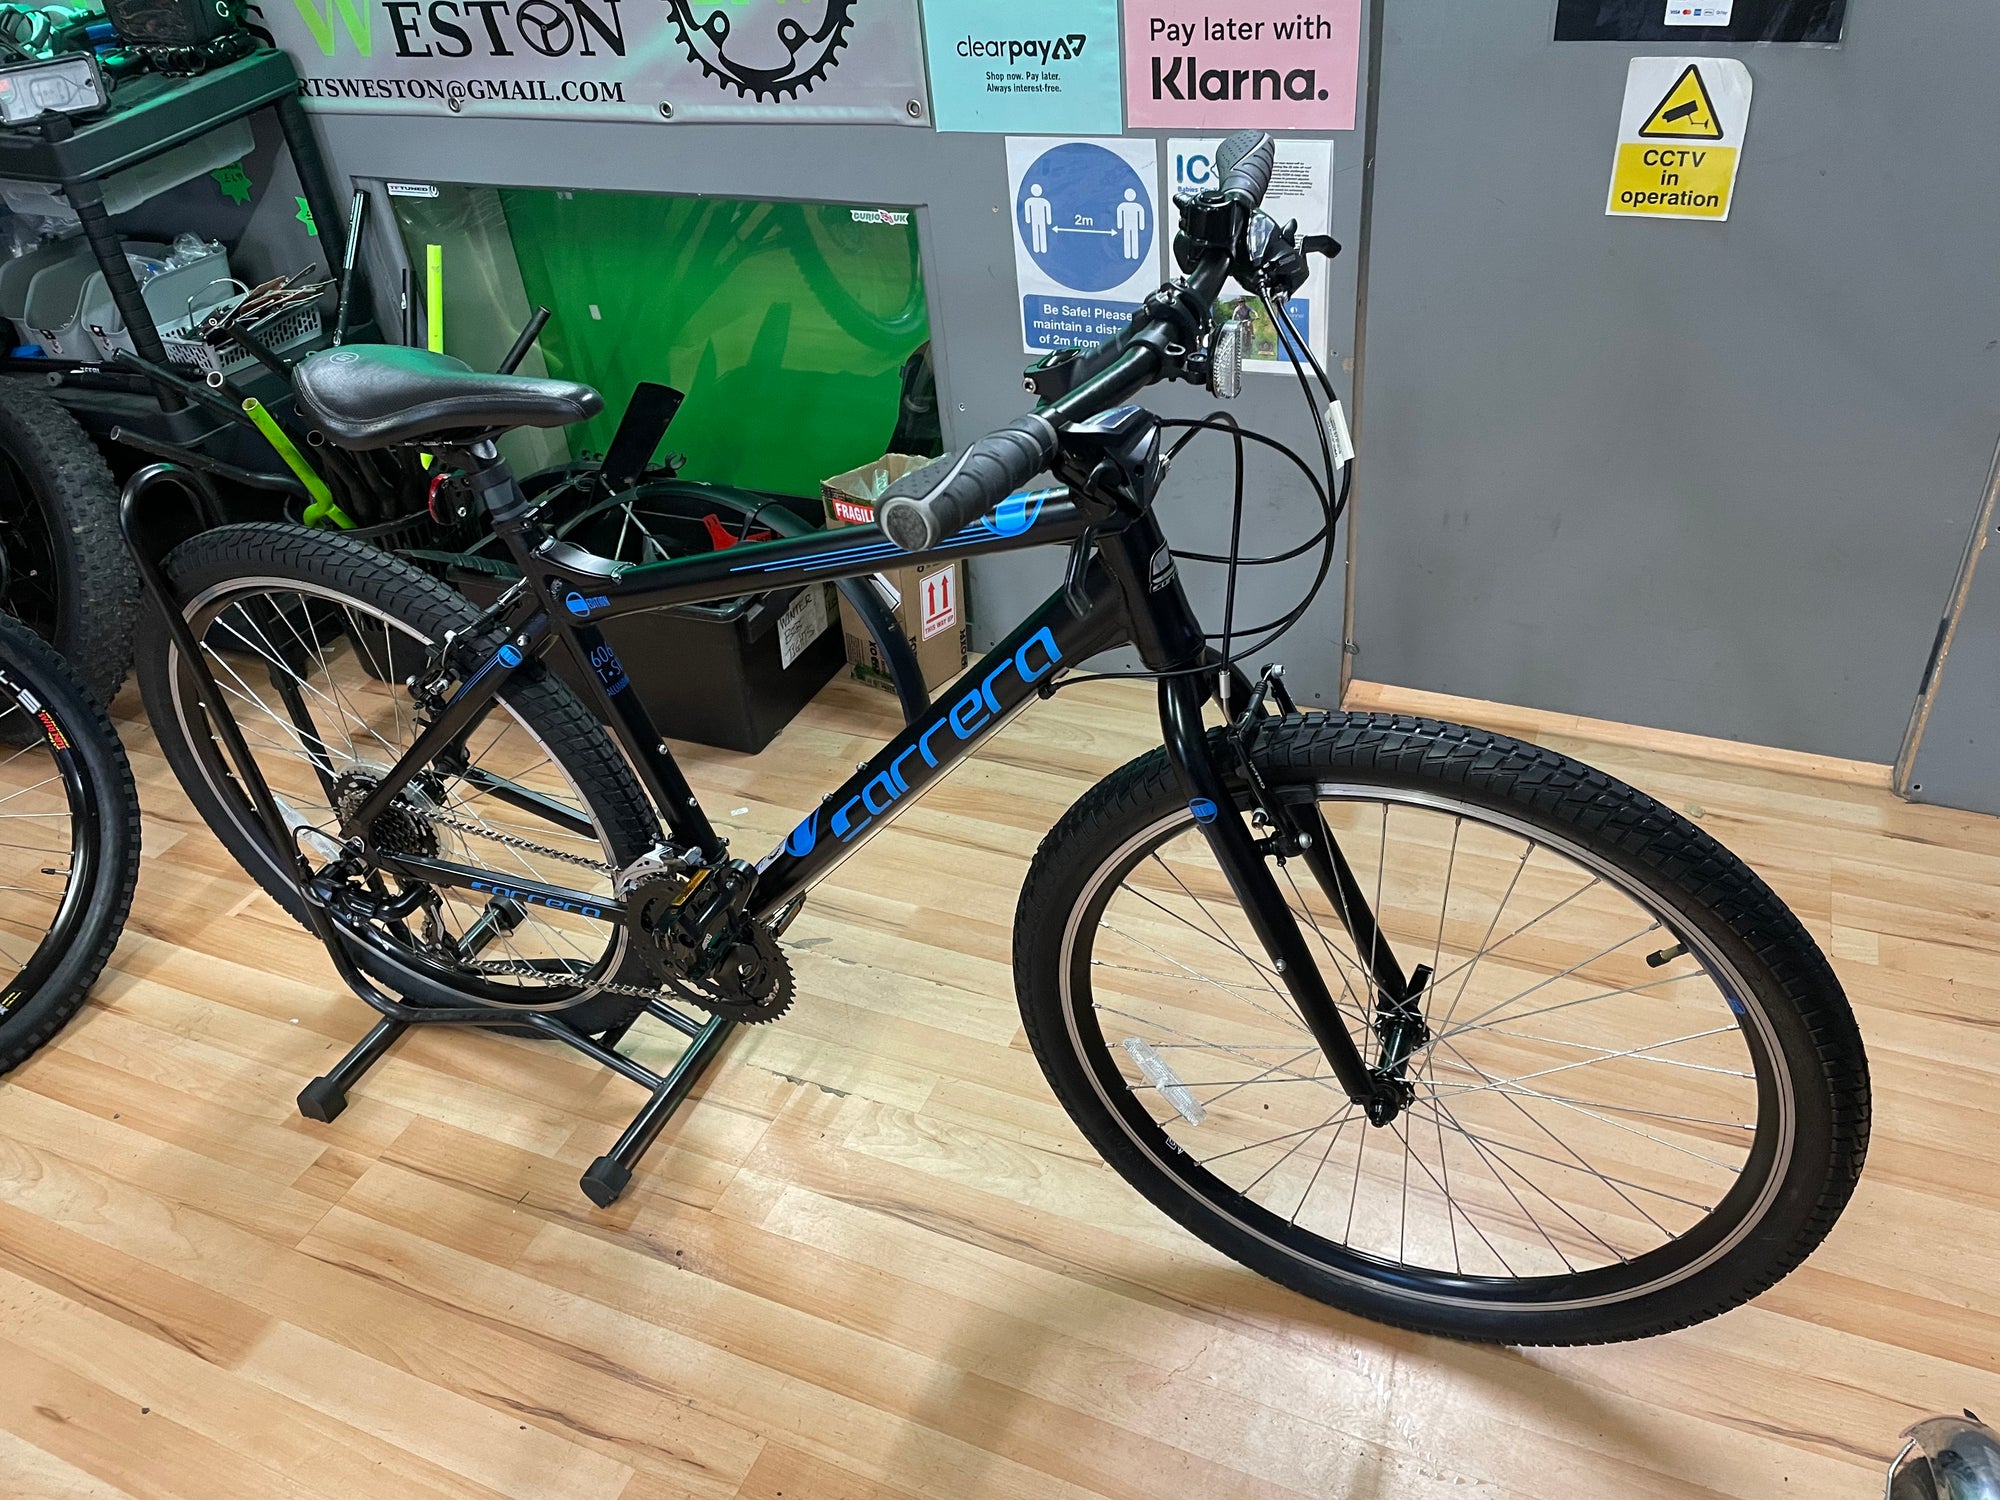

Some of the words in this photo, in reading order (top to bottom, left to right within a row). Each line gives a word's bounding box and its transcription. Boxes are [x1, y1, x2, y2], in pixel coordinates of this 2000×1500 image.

[1150, 18, 1196, 46] Pay
[1204, 17, 1265, 40] later
[1273, 14, 1331, 40] with
[957, 35, 1051, 65] clearpay
[986, 72, 1004, 81] Shop
[1026, 72, 1039, 81] Pay
[1042, 72, 1060, 80] later.
[1151, 56, 1329, 101] Klarna.
[987, 84, 1011, 93] Always
[1014, 84, 1061, 92] interest-free.
[1643, 149, 1706, 168] CCTV
[1660, 170, 1679, 186] in
[1620, 190, 1719, 207] operation
[1074, 214, 1094, 226] 2m
[1043, 303, 1059, 315] Be
[1061, 305, 1091, 318] Safe!
[1094, 308, 1133, 321] Please
[1033, 319, 1082, 332] maintain
[1085, 324, 1092, 333] a
[1039, 334, 1050, 344] of
[1053, 335, 1071, 346] 2m
[1073, 337, 1100, 348] from
[830, 626, 1063, 843] carrera
[470, 881, 601, 918] carrera
